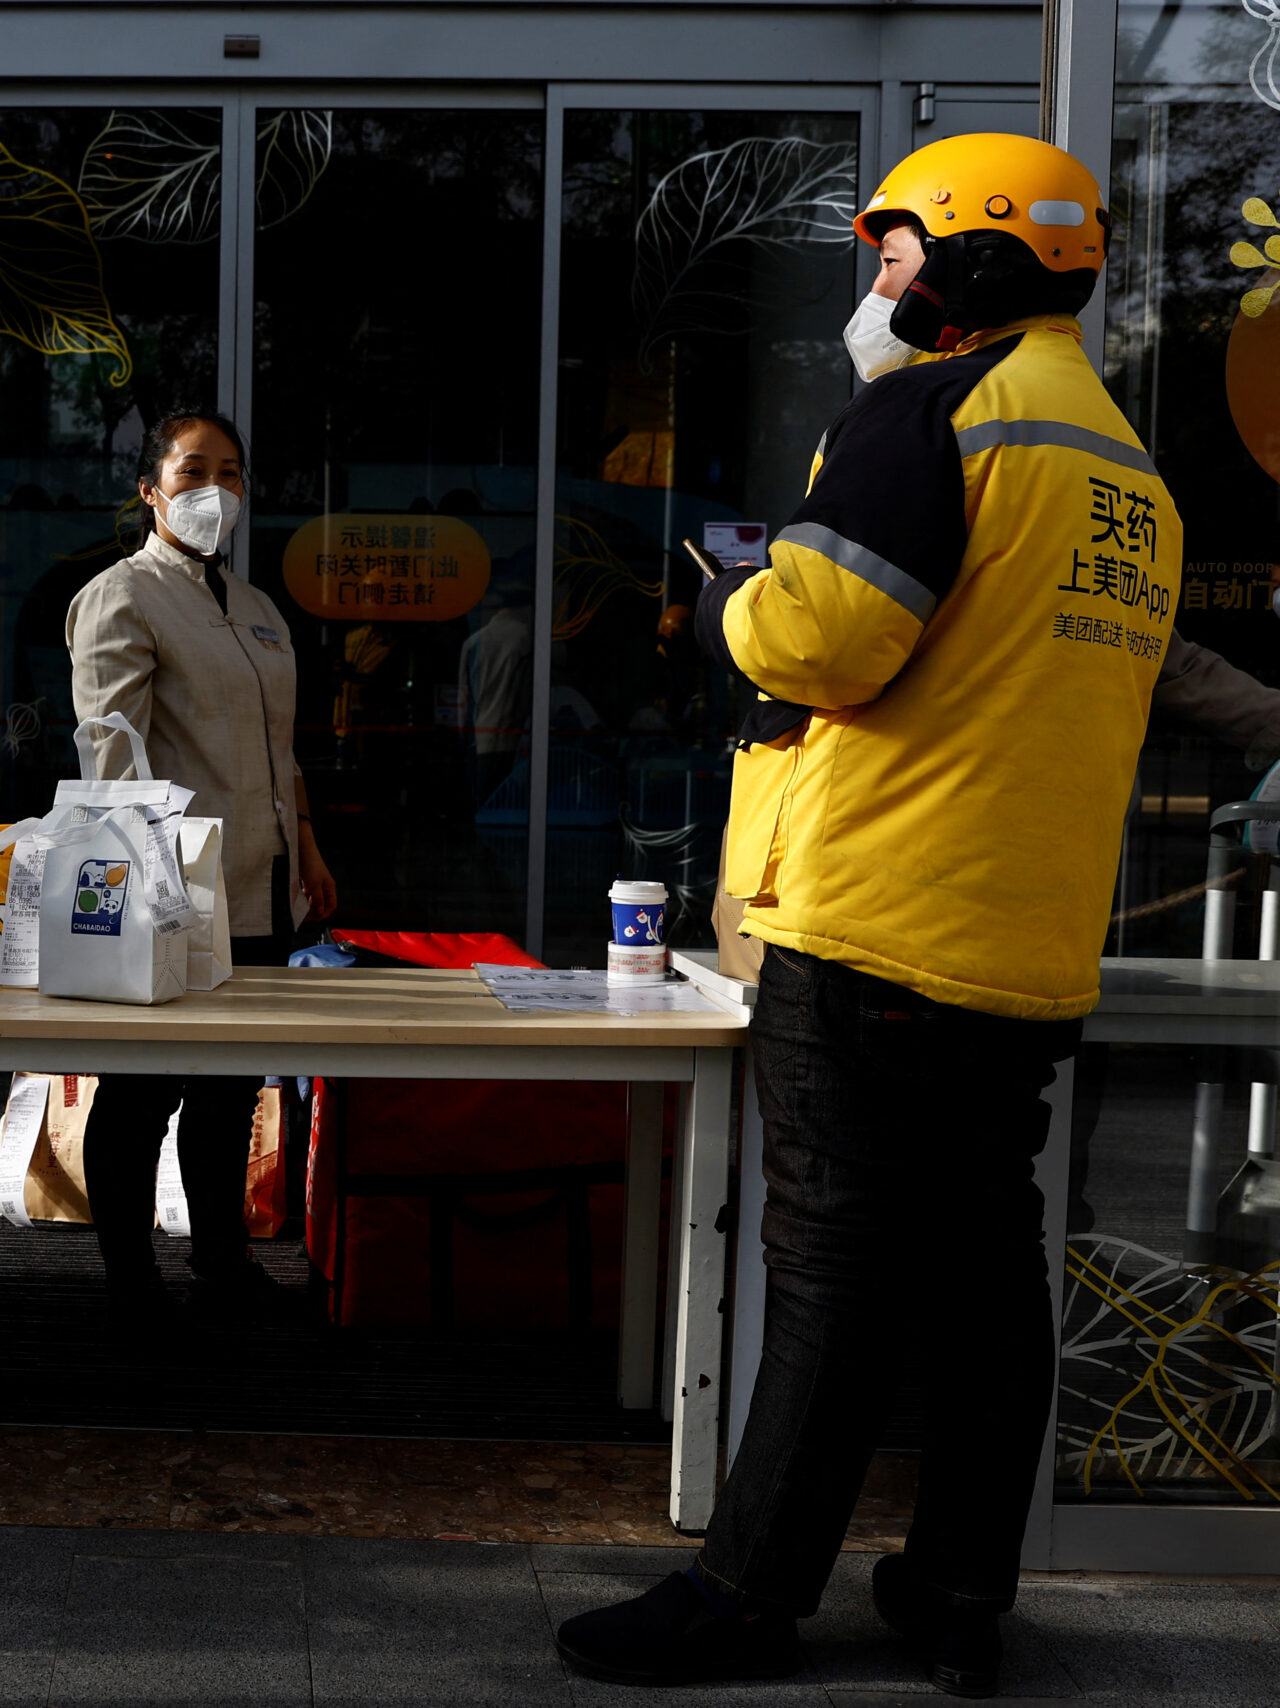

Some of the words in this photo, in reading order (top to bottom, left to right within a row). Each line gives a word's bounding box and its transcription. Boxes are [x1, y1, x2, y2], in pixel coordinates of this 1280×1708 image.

[1088, 476, 1157, 563] 买药
[1184, 561, 1228, 574] AUTO
[1057, 548, 1170, 624] 上美团App
[1183, 577, 1275, 611] 自动门
[1052, 612, 1123, 648] 美团配送
[72, 922, 112, 932] CHABAIDAO
